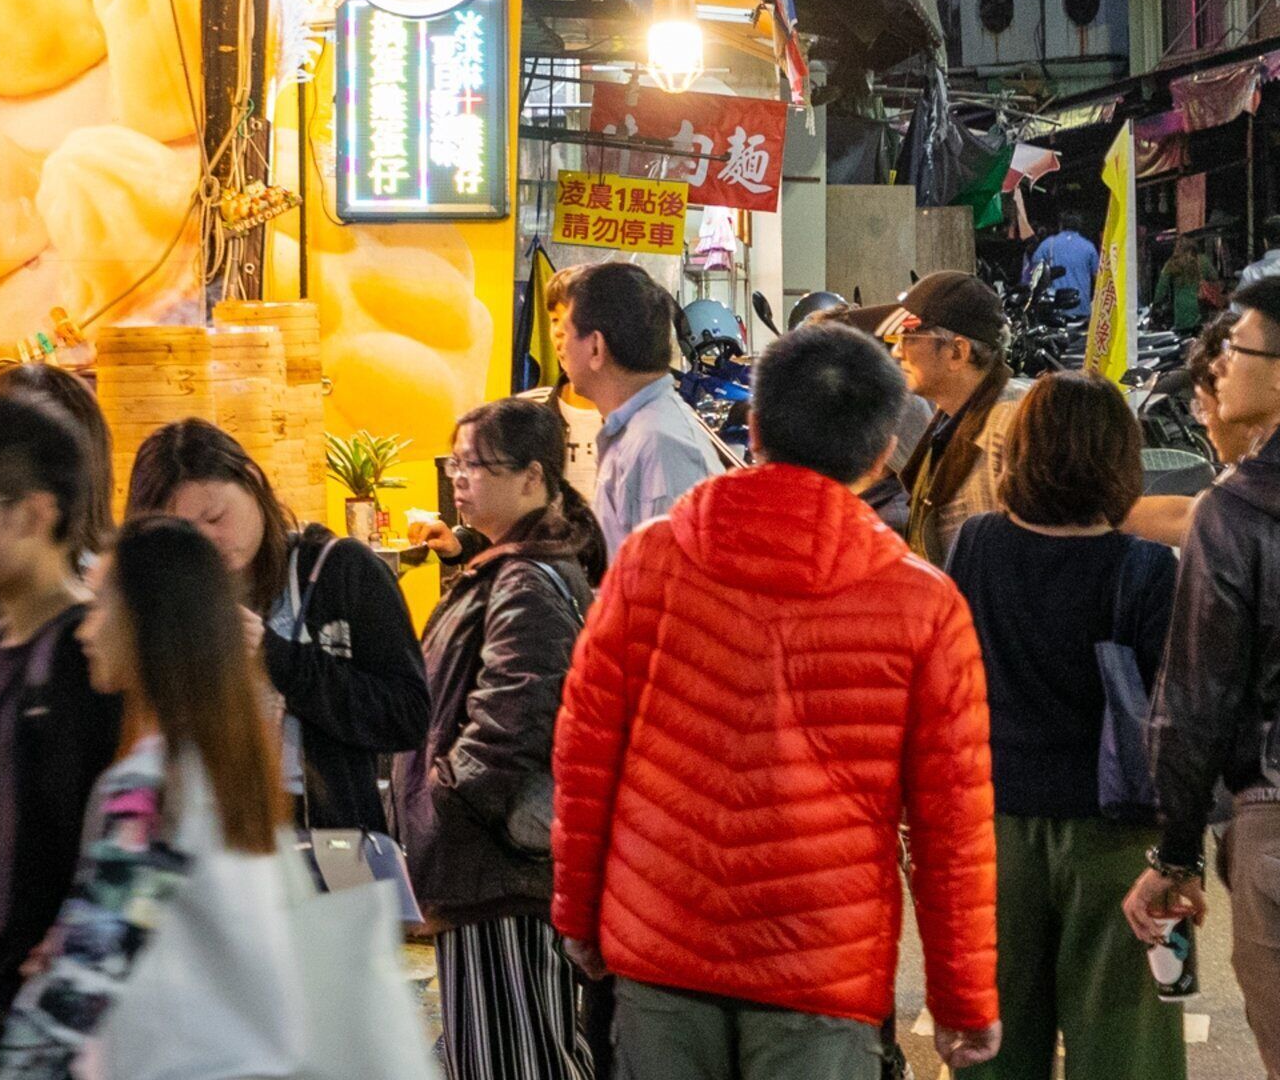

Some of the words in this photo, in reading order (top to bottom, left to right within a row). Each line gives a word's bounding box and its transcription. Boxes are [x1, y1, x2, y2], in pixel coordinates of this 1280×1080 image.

[558, 179, 684, 219] 凌晨1點後
[234, 202, 289, 232] WELCOME
[561, 213, 675, 248] 請勿停車
